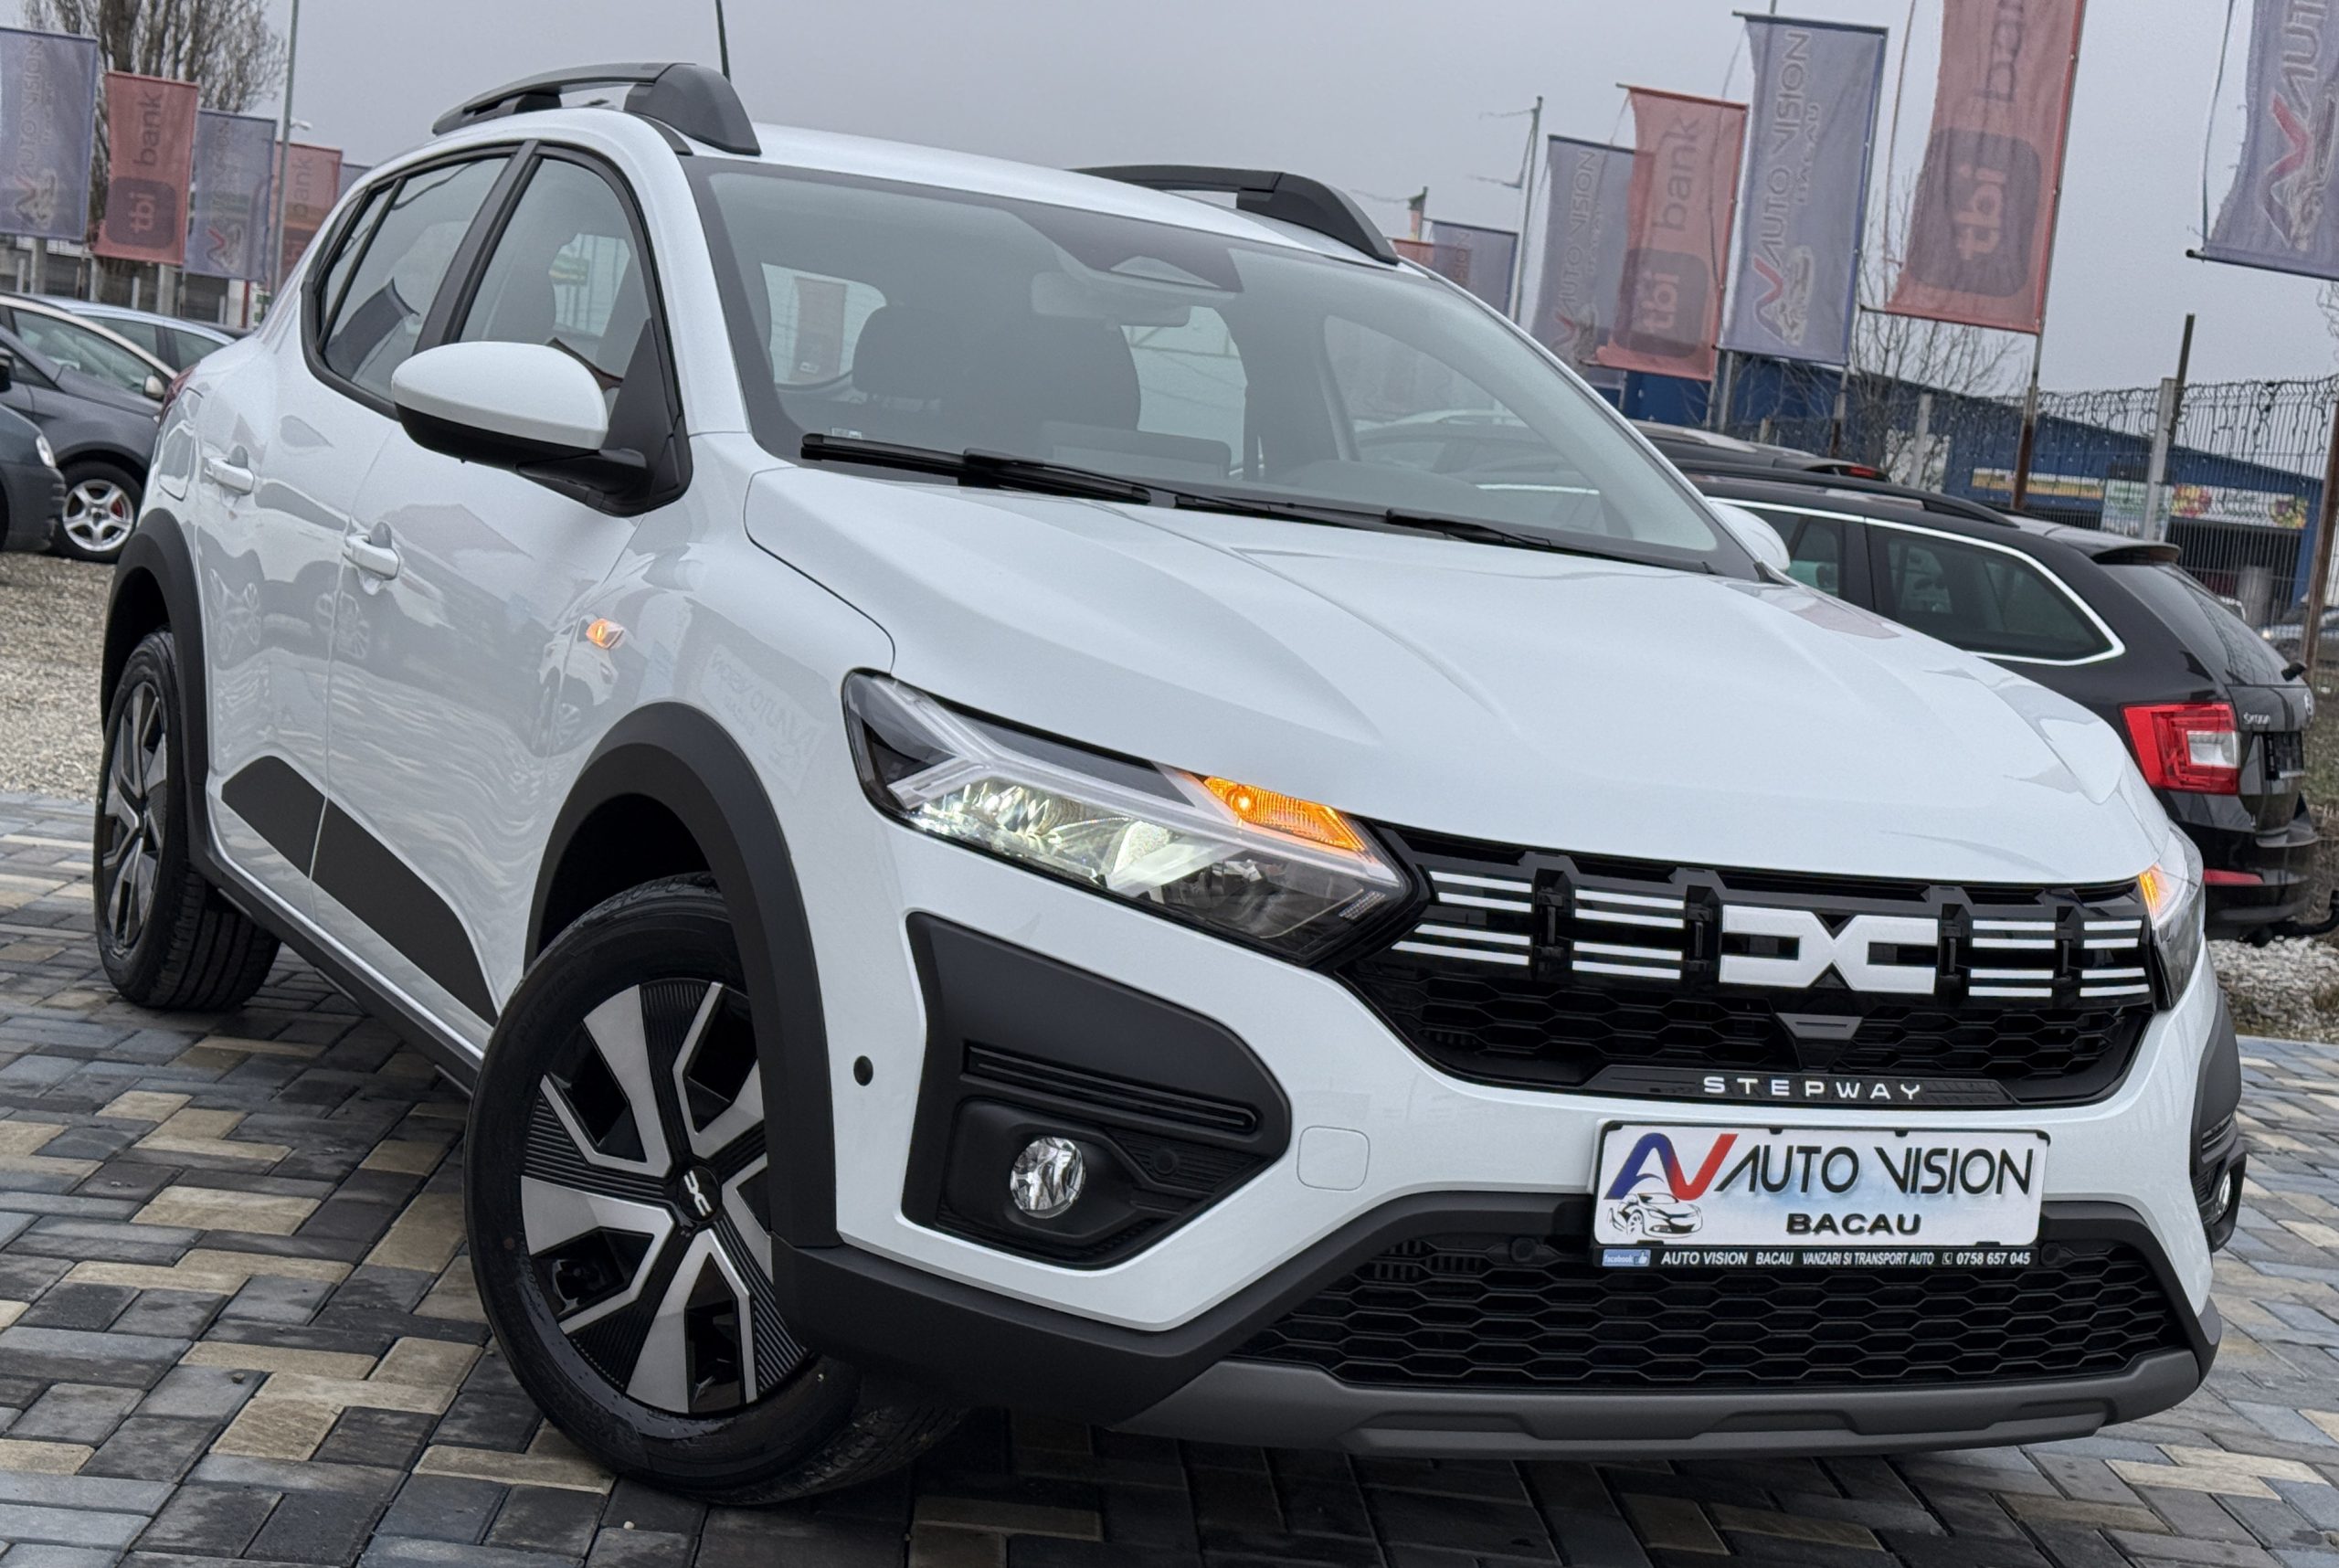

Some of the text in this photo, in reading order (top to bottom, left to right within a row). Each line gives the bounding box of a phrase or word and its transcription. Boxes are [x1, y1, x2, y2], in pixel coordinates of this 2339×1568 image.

[1773, 31, 1810, 154] VISION
[128, 91, 163, 234] tbi bank
[1643, 117, 1699, 330] tbi bank
[1760, 166, 1792, 266] AUTO
[1955, 164, 2007, 260] tbi
[1702, 1075, 1922, 1101] STEPWAY
[1714, 1144, 1860, 1193] AUTO
[1873, 1146, 2034, 1195] VISION
[1604, 1254, 1634, 1265] facebook
[1661, 1252, 1700, 1266] AUTO
[1703, 1252, 1749, 1266] VISION
[1755, 1252, 1794, 1266] BACAU
[1803, 1252, 1841, 1266] VANZARI
[1854, 1252, 1908, 1266] TRANSPORT
[1909, 1252, 1935, 1266] AUTO
[1956, 1252, 1984, 1266] 0758
[1986, 1252, 2008, 1266] 657
[2010, 1252, 2031, 1266] 045
[1786, 1213, 1922, 1235] BACAU
